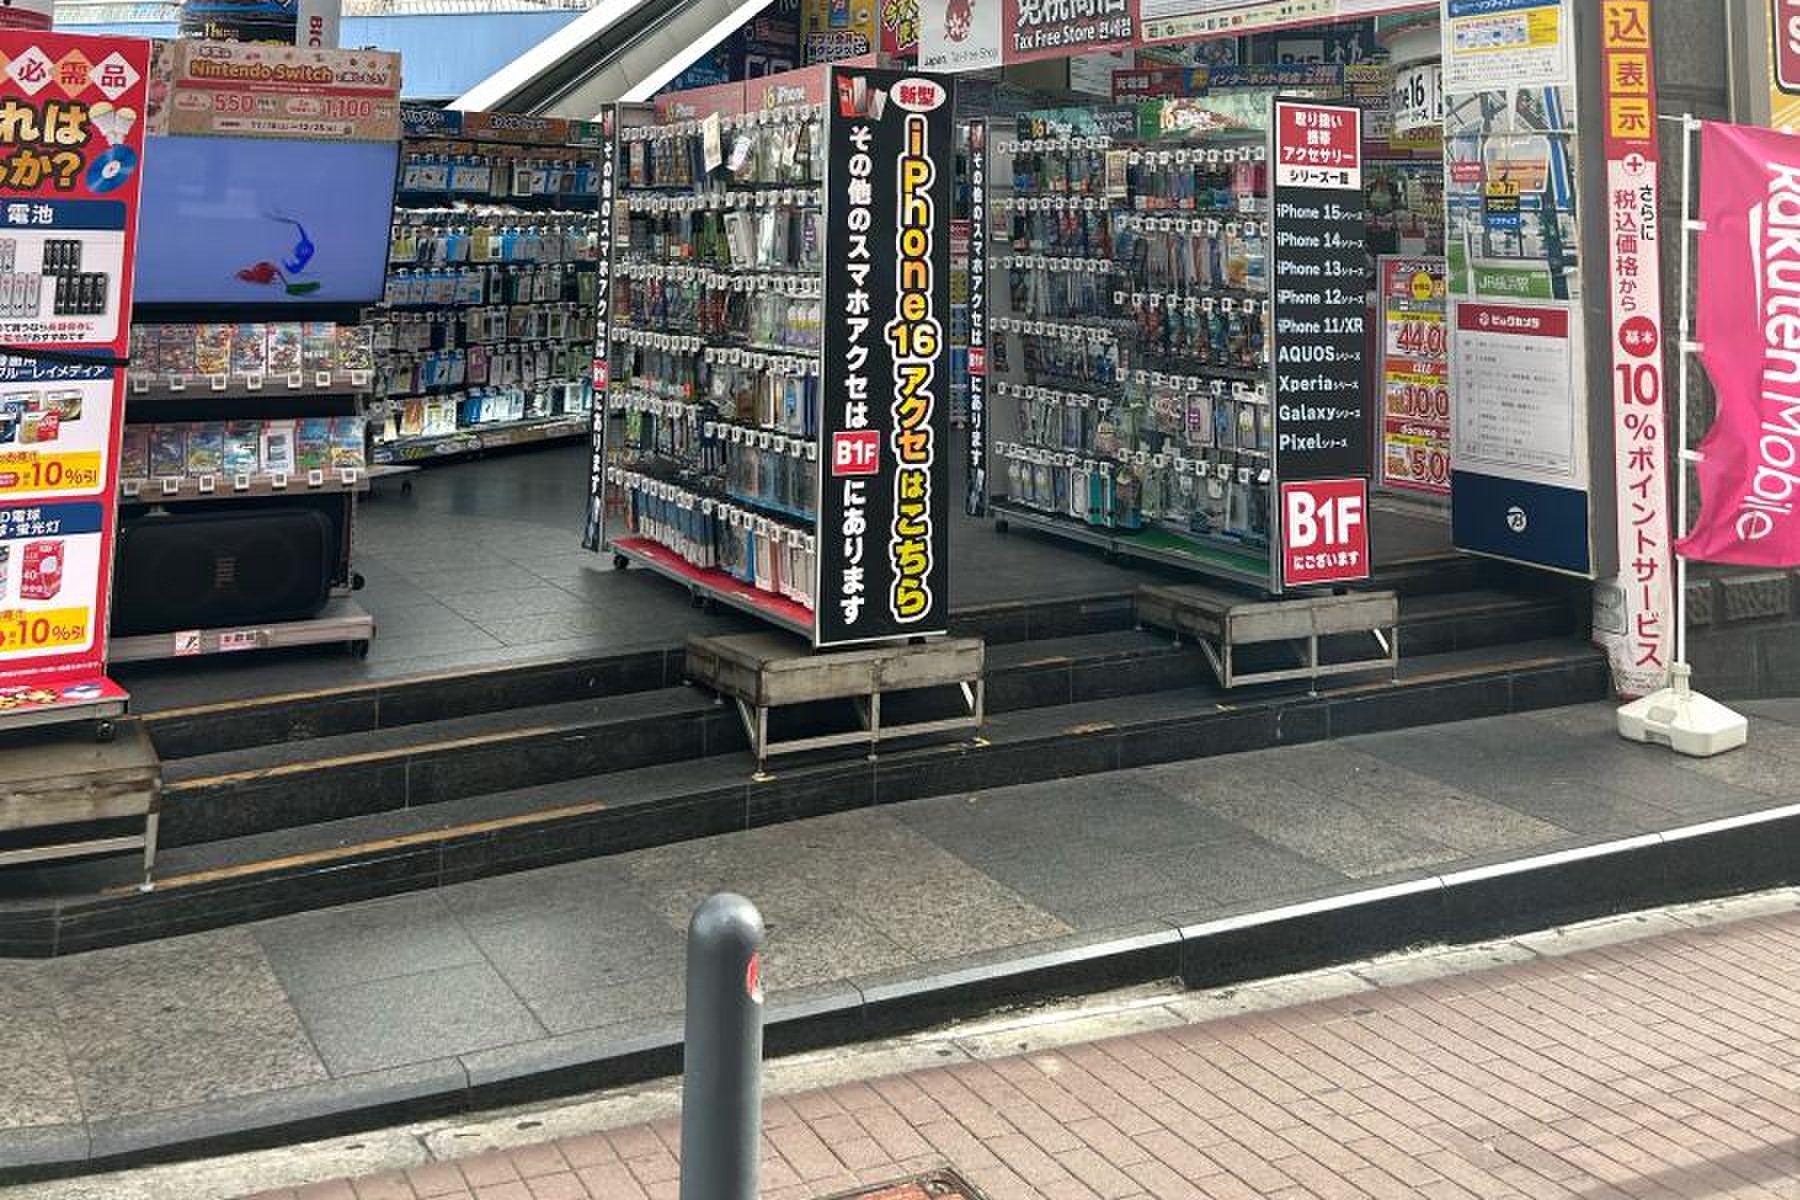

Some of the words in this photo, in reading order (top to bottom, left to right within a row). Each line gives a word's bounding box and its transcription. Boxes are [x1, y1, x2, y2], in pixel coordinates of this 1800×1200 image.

[1014, 32, 1033, 49] Tax
[1035, 29, 1061, 48] Free
[1064, 23, 1095, 44] Store
[18, 57, 127, 89] 必需品
[190, 60, 272, 82] Nintendo
[273, 64, 335, 84] Switch
[899, 85, 936, 106] 新型
[1295, 111, 1343, 129] 取り扱い
[1284, 146, 1354, 164] アクセサリー
[1277, 204, 1319, 221] iPhone
[1640, 184, 1654, 241] さらに
[1277, 232, 1319, 249] iPhone
[1615, 189, 1638, 312] 税込価格から
[1277, 261, 1319, 276] iPhone
[1278, 289, 1320, 305] iPhone
[1278, 318, 1320, 334] iPhone
[1324, 318, 1364, 334] 11/XR
[1491, 315, 1540, 329] ビックカメラ
[837, 440, 876, 466] B1F
[1287, 491, 1361, 548] B1F
[840, 479, 866, 624] にあります
[1294, 550, 1359, 570] にございます
